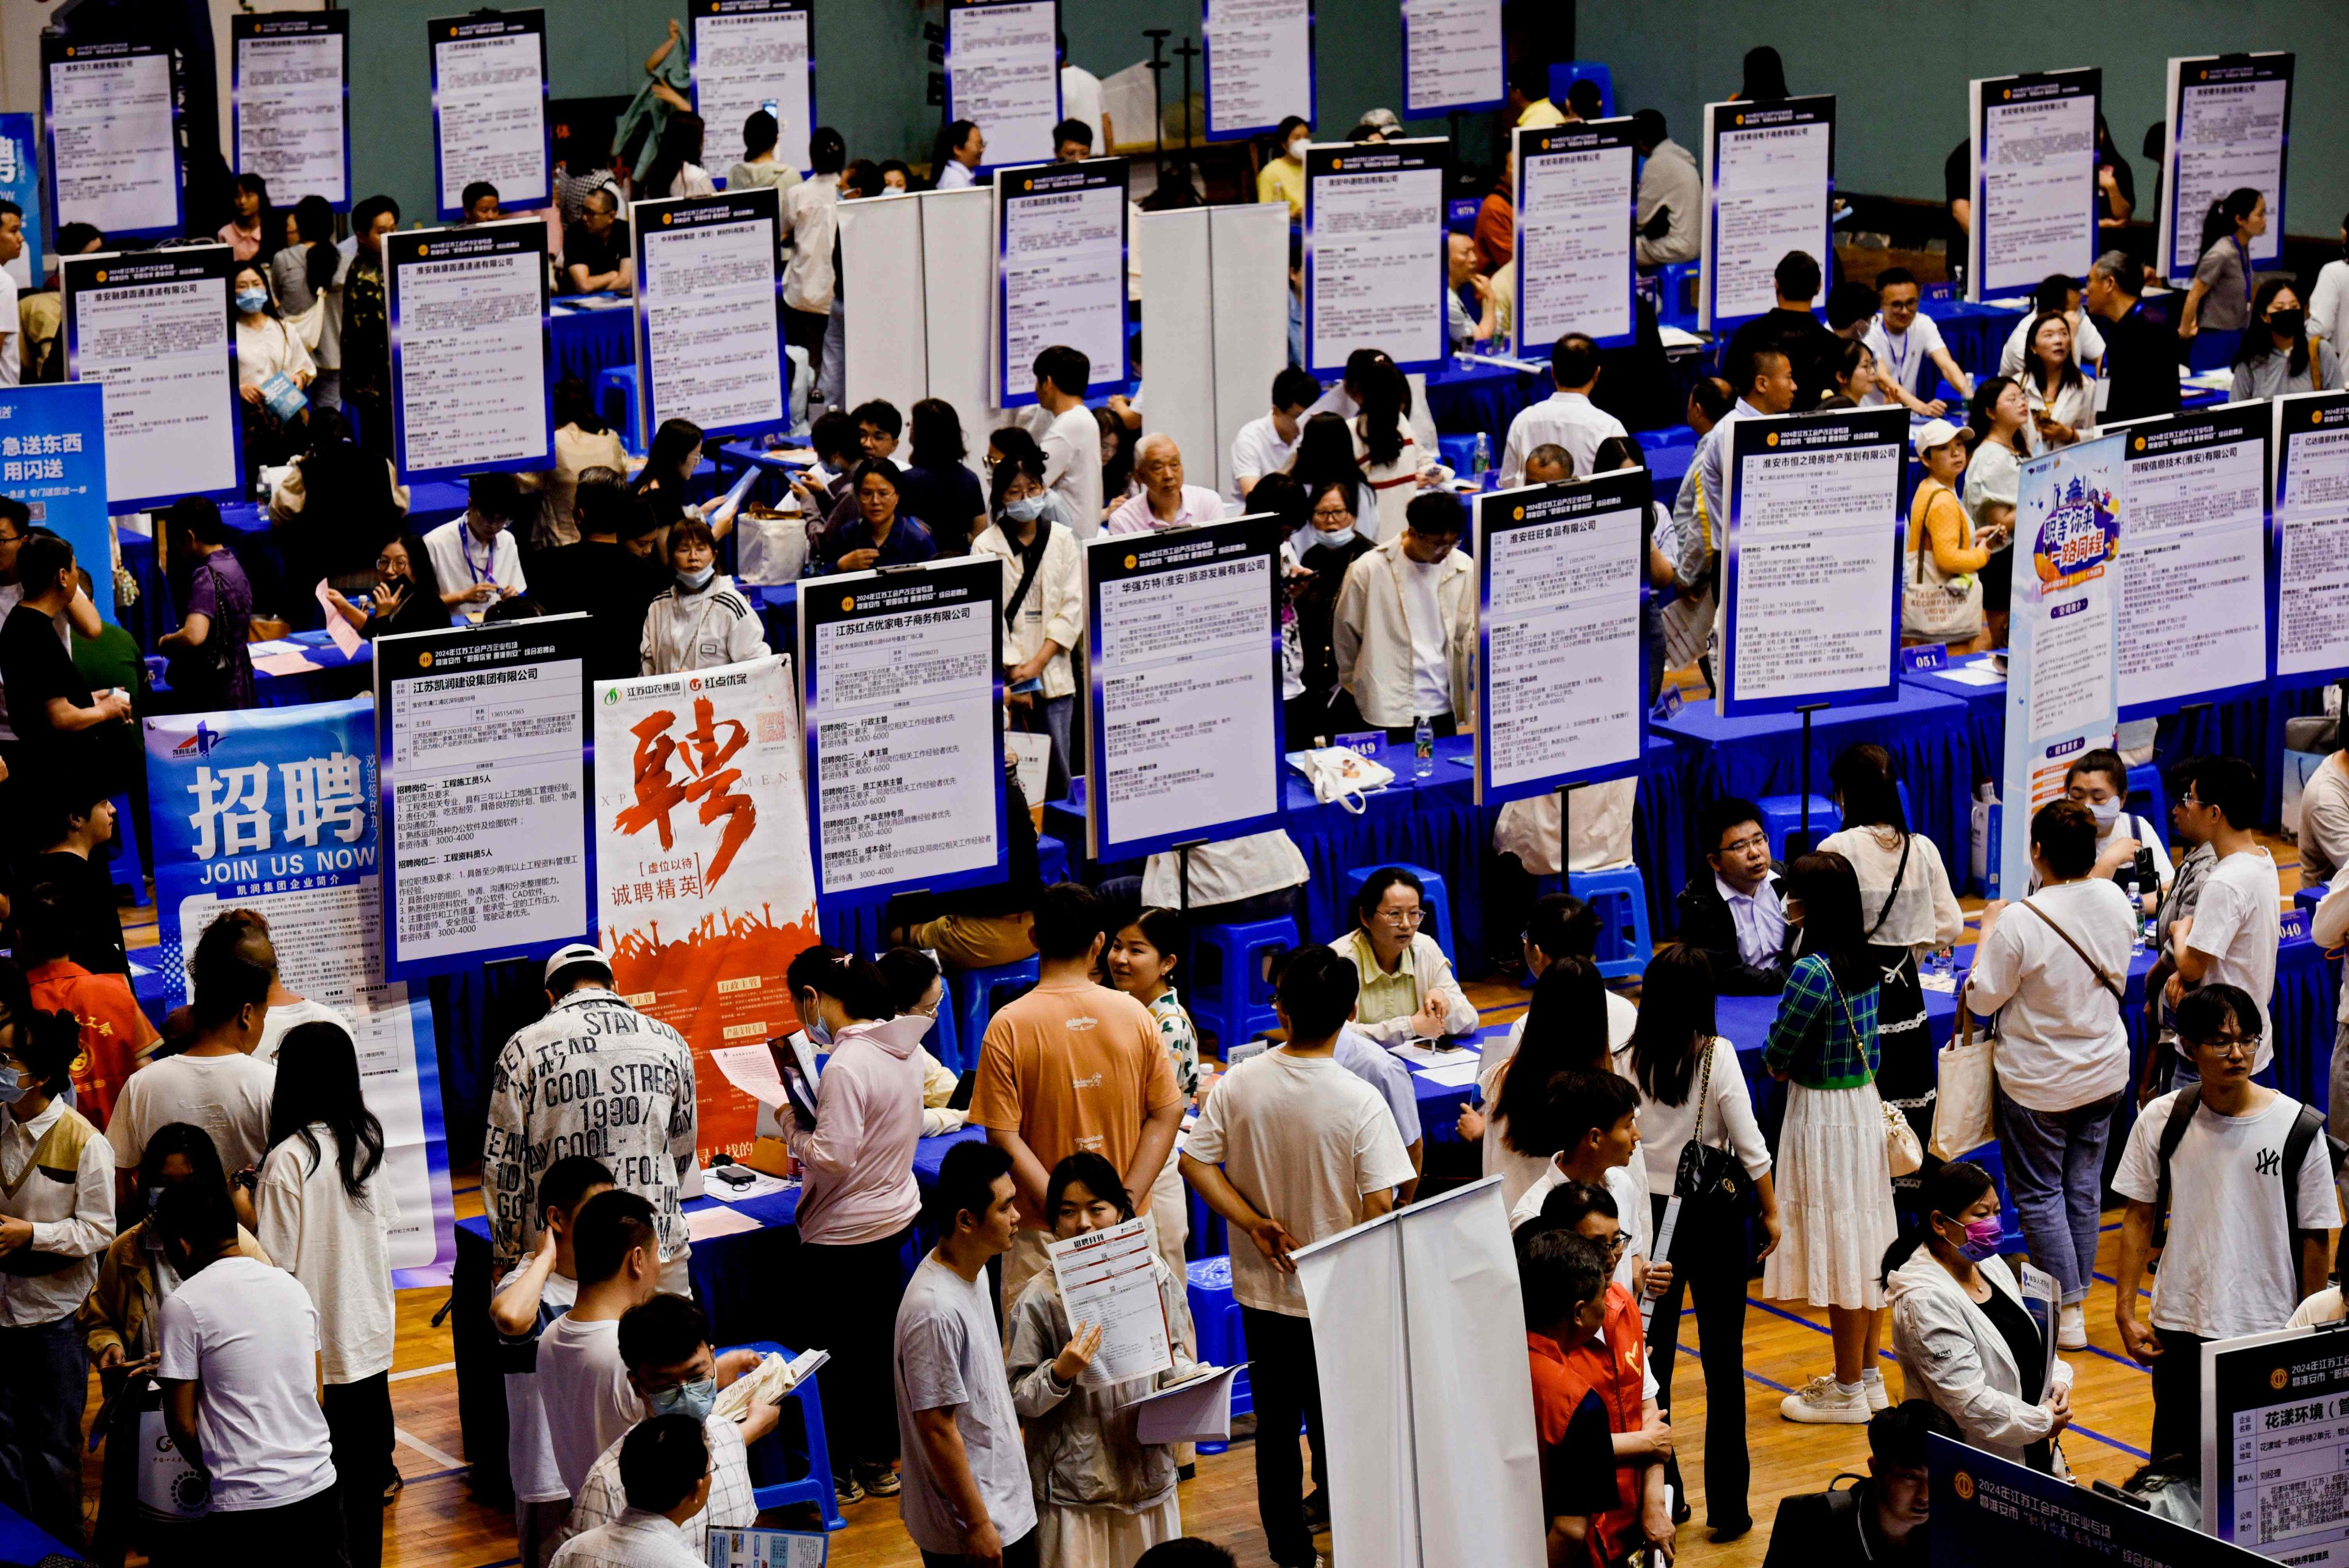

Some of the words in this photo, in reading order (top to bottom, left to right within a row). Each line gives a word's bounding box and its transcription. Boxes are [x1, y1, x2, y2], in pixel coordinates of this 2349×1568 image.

[4, 459, 64, 482] 用闪送
[1510, 520, 1596, 544] 淮安旺旺食品有限公司
[2044, 504, 2094, 543] 职等你来
[2052, 531, 2104, 564] 一路同程
[1122, 560, 1265, 594] 华强方特(淮安)旅游发展有限公司
[836, 607, 970, 637] 江苏红点优家电子商务有限公司
[1915, 655, 1937, 668] 051
[413, 668, 538, 694] 江苏凯润建设集团有限公司
[627, 682, 680, 697] 江苏中农集团
[705, 673, 747, 688] 红点优家
[821, 716, 888, 733] 招聘岗位一：行政主管
[821, 747, 888, 765] 招聘岗位二：人事主管
[1350, 742, 1376, 755] 049
[397, 775, 491, 795] 招聘岗位一：工程施工员5人
[822, 777, 903, 797] 招聘岗位三：员工关系主管
[397, 790, 453, 803] 职位职责及要求：
[612, 695, 757, 896] 聘
[186, 752, 366, 860] 招聘
[823, 809, 904, 829] 招聘岗位四：产品支持专员
[398, 833, 474, 850] 薪资待遇：3000-4000
[399, 848, 493, 869] 招聘岗位二：工程资料员5人
[825, 844, 892, 861] 招聘岗位五：成本会计
[200, 859, 257, 884] JOIN
[271, 854, 304, 876] US
[317, 846, 375, 871] NOW
[648, 857, 693, 875] 虚位以待
[236, 874, 340, 896] 凯润集团企业简介
[611, 875, 699, 906] 诚聘精英
[400, 925, 476, 943] 薪资待遇：3000-4000
[2280, 923, 2301, 939] 040
[721, 977, 759, 992] 行政主管
[583, 1009, 639, 1036] STAY
[726, 1023, 764, 1037] 产品支持专员
[544, 1068, 605, 1107] COOL
[554, 1128, 616, 1159] COOL
[2260, 1469, 2281, 1480] 刘经理
[1978, 1478, 2111, 1539] 2024年江苏工会产改企业专场
